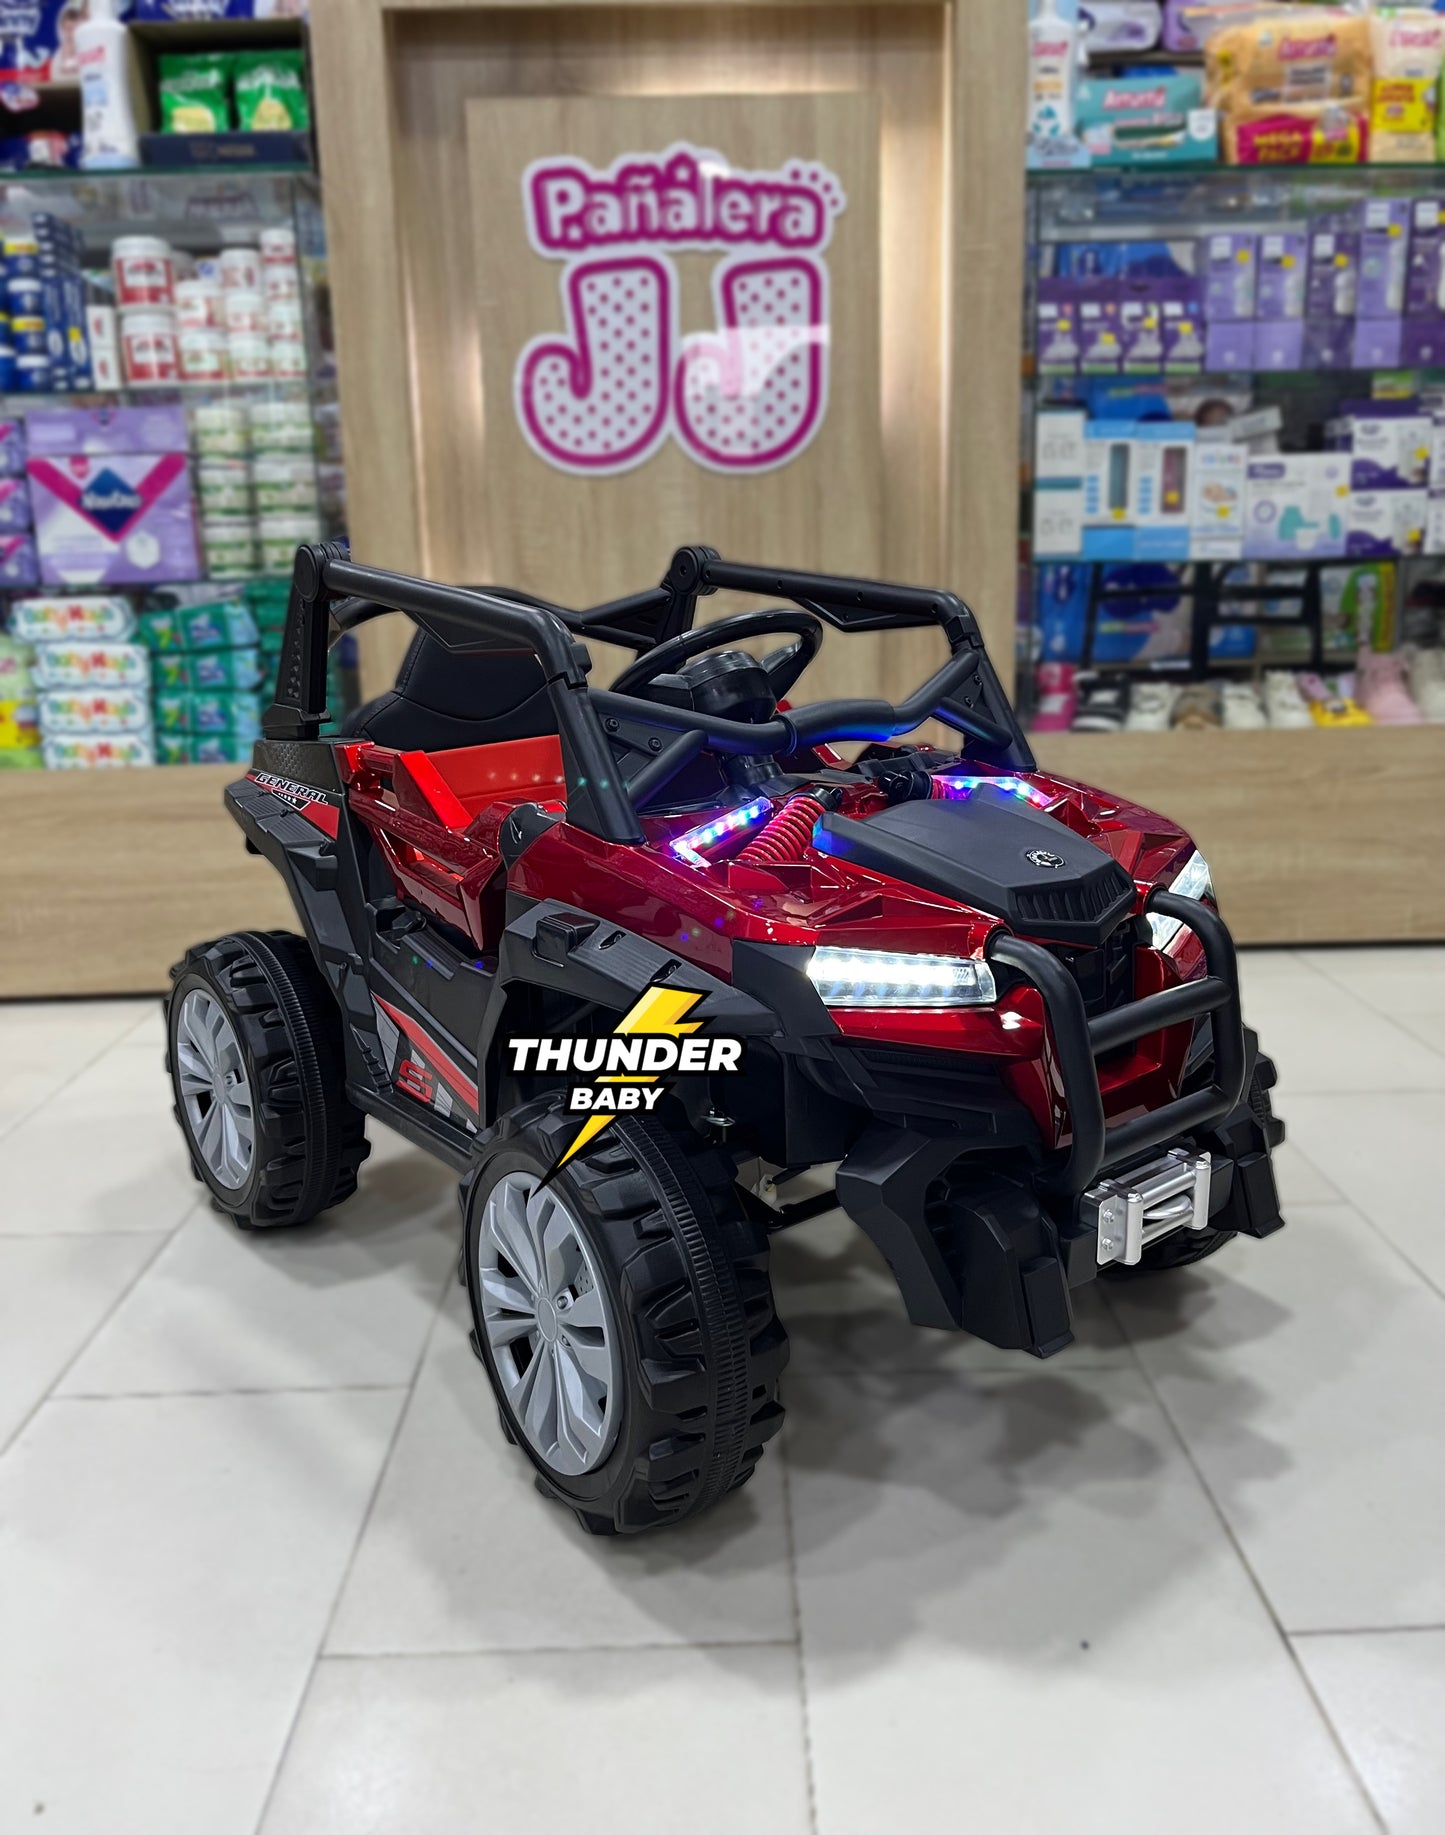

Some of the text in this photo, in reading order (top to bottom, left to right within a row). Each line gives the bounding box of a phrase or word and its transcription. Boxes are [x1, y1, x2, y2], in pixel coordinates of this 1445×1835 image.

[536, 160, 821, 246] Pañalera
[519, 254, 824, 469] JJ
[255, 772, 329, 806] GENERAL
